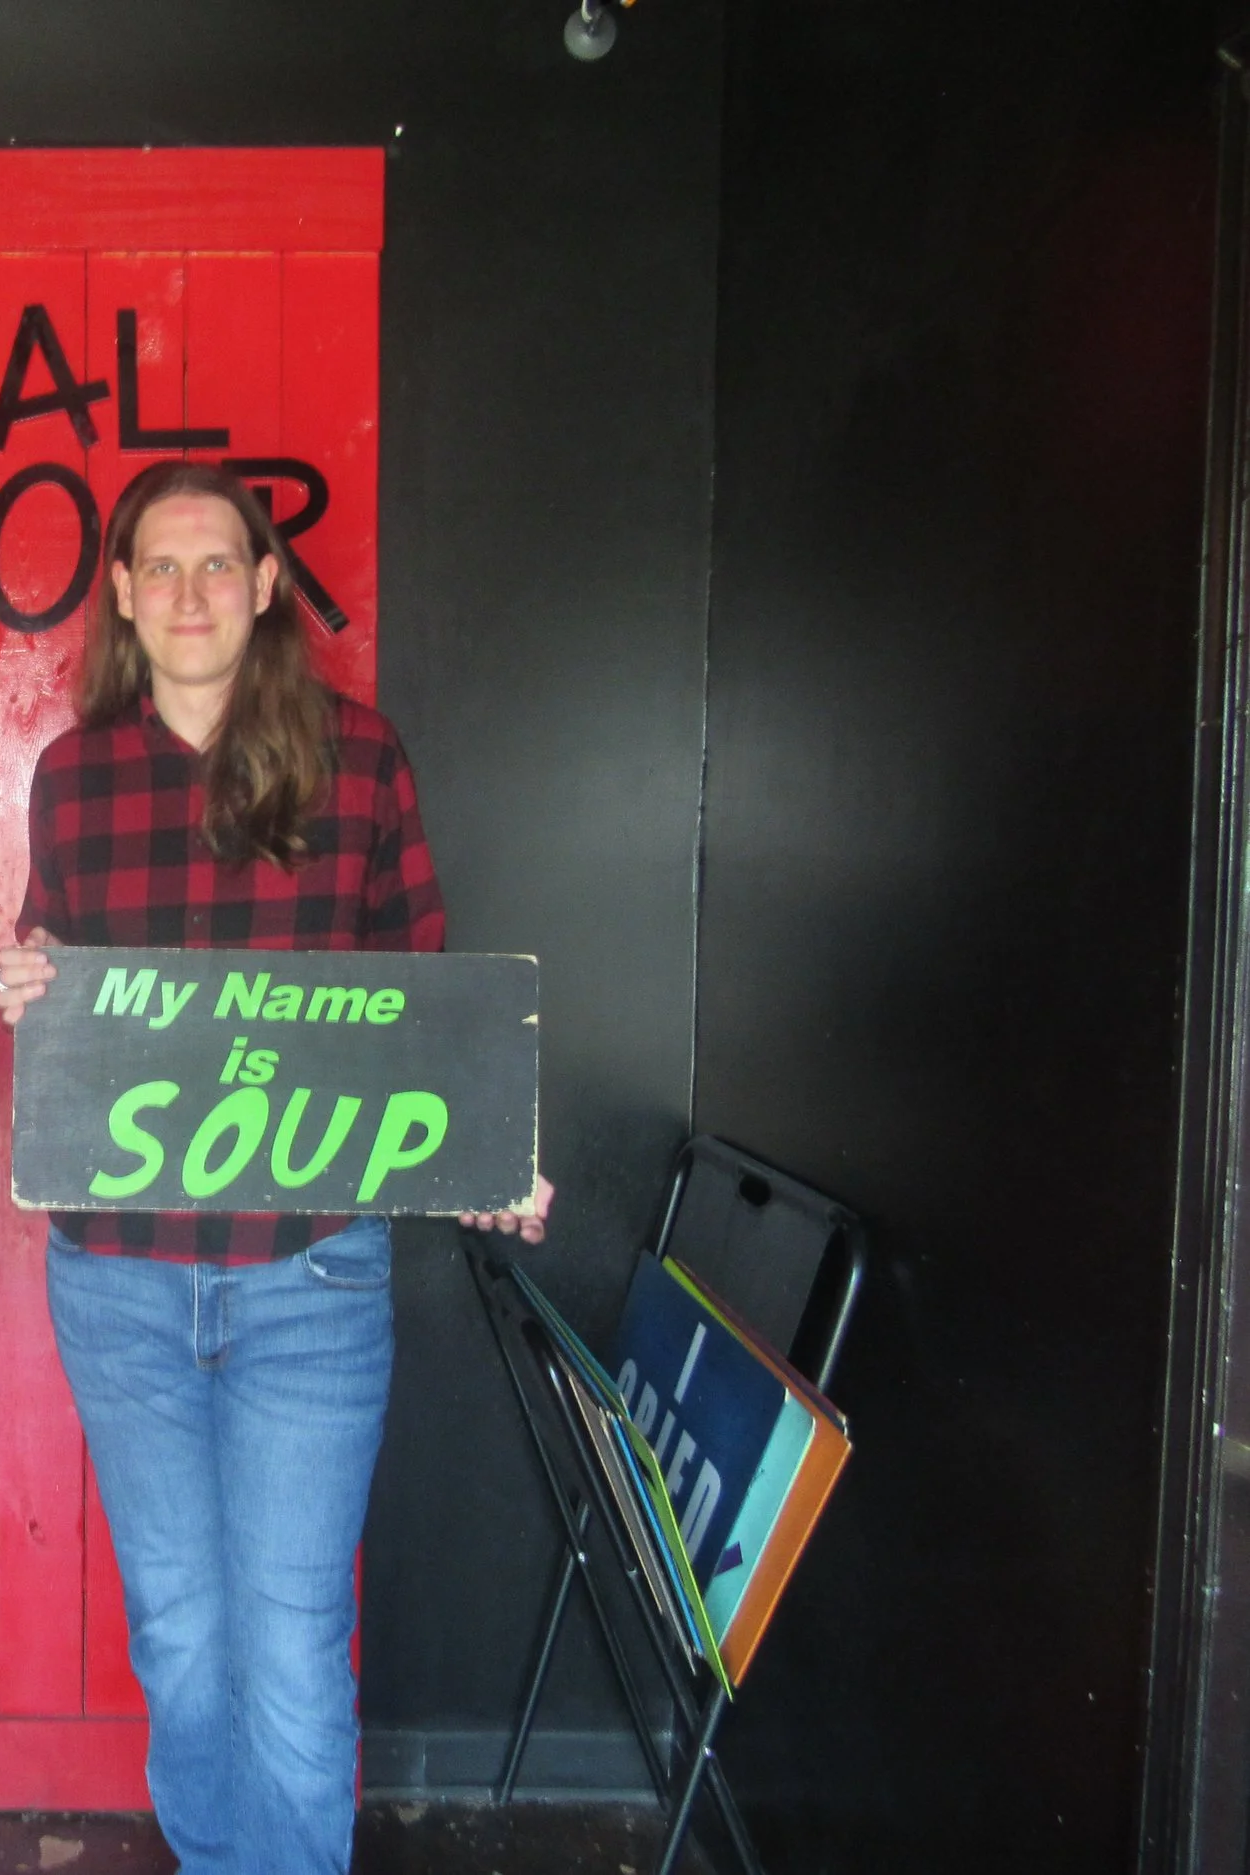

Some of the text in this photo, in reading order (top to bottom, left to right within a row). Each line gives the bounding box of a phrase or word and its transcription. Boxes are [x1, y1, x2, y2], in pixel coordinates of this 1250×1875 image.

[92, 966, 407, 1031] My Name
[218, 1035, 280, 1086] is
[87, 1079, 451, 1205] SOUP
[673, 1321, 708, 1405] I
